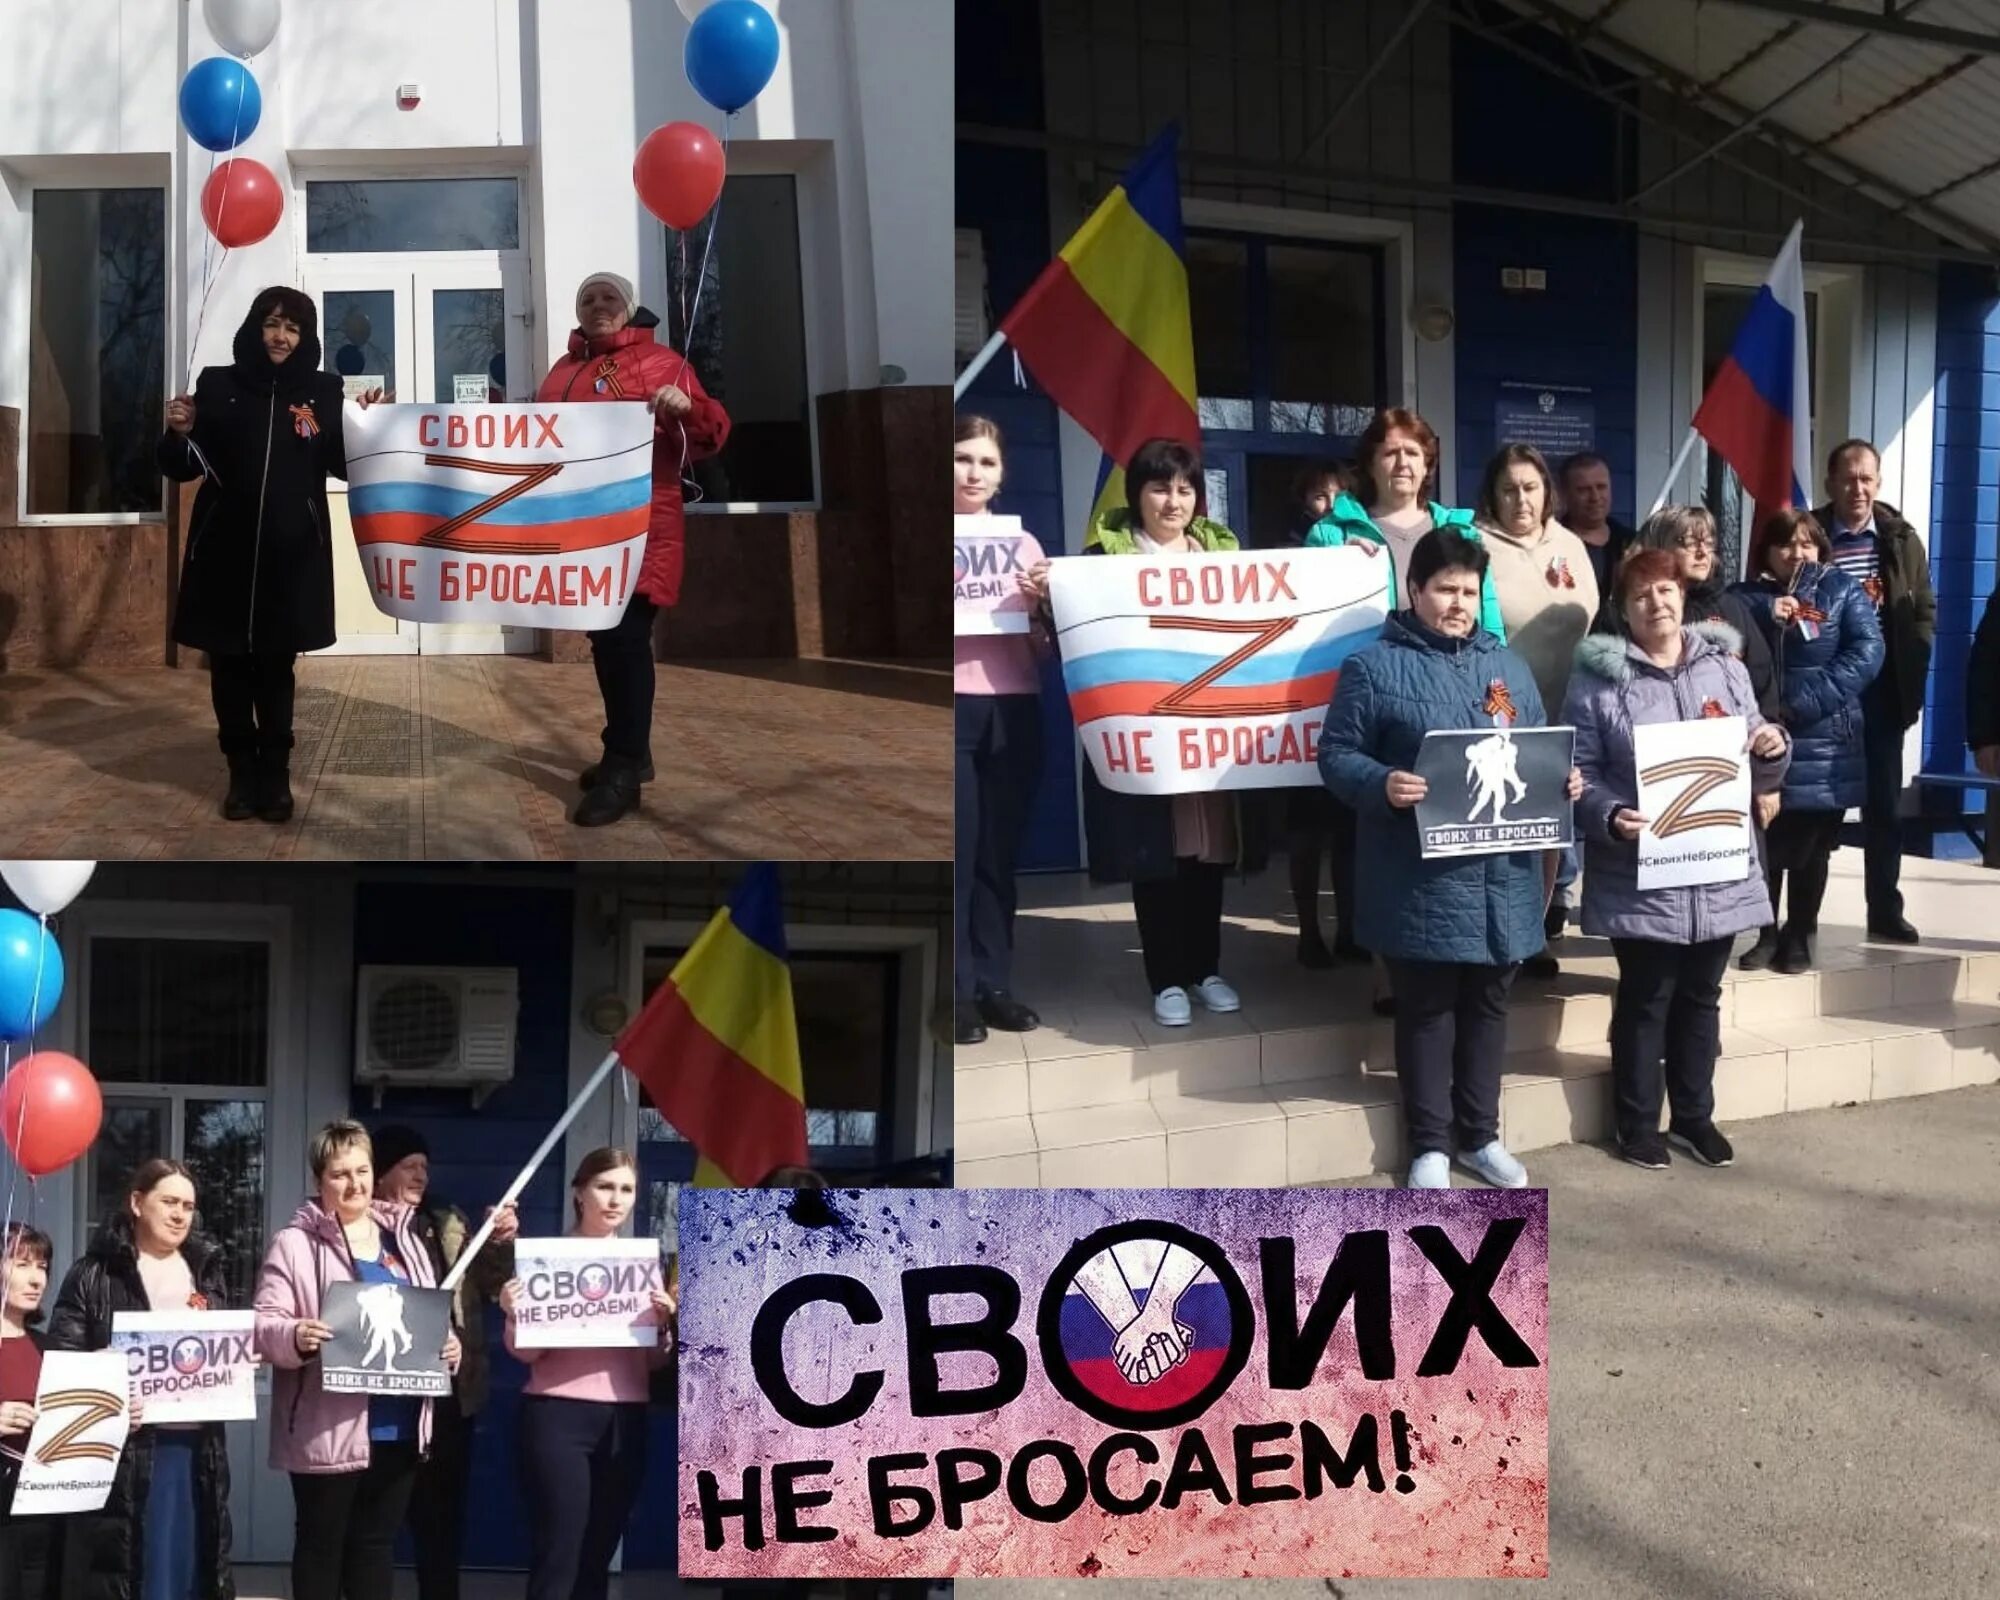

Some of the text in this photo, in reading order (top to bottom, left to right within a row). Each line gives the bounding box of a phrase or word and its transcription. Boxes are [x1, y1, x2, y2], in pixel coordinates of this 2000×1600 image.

[419, 414, 564, 448] СВОИХ
[374, 547, 631, 606] НЕ БРОСАЕМ!
[1138, 562, 1298, 607] СВОИХ
[1101, 720, 1321, 773] НЕ БРОСАЕ
[1427, 824, 1559, 844] СВОИХ НЕ БРОСАЕМ!
[527, 1263, 658, 1301] СВОИХ
[518, 1296, 638, 1323] НЕ БРОСАЕМ!
[126, 1336, 253, 1376] СВОИХ
[141, 1370, 232, 1396] БРОСАЕМ!
